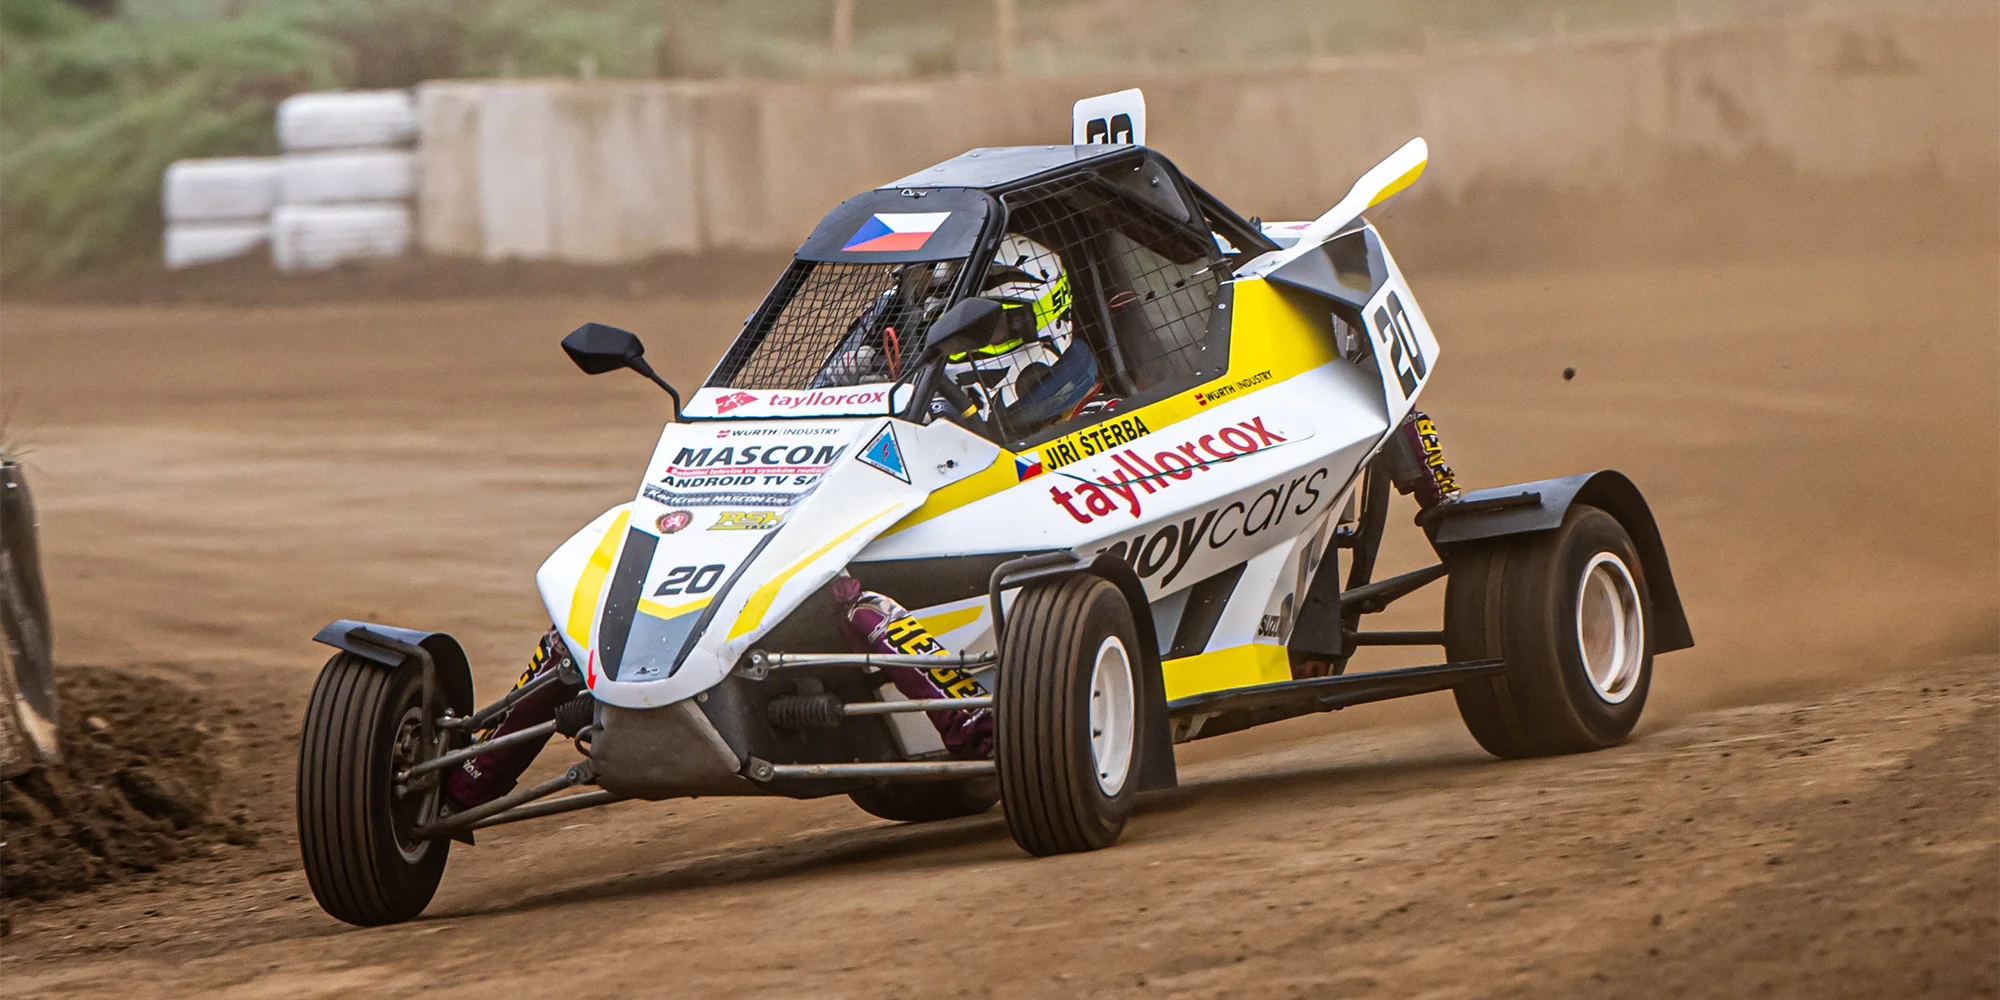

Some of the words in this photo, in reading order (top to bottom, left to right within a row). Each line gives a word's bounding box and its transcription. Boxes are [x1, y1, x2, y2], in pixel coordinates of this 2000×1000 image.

[1373, 289, 1426, 401] 20
[1236, 370, 1272, 389] INDUSTRY
[769, 390, 887, 408] tayllorcox
[783, 427, 840, 436] INDUSTRY
[1045, 435, 1081, 470] JIŘÍ
[1079, 415, 1150, 457] ŠTĚRBA
[672, 443, 850, 467] MASCOM
[661, 476, 756, 488] ANDROID
[763, 475, 789, 486] TV
[1049, 416, 1287, 524] tayllorcox
[653, 563, 726, 597] 20
